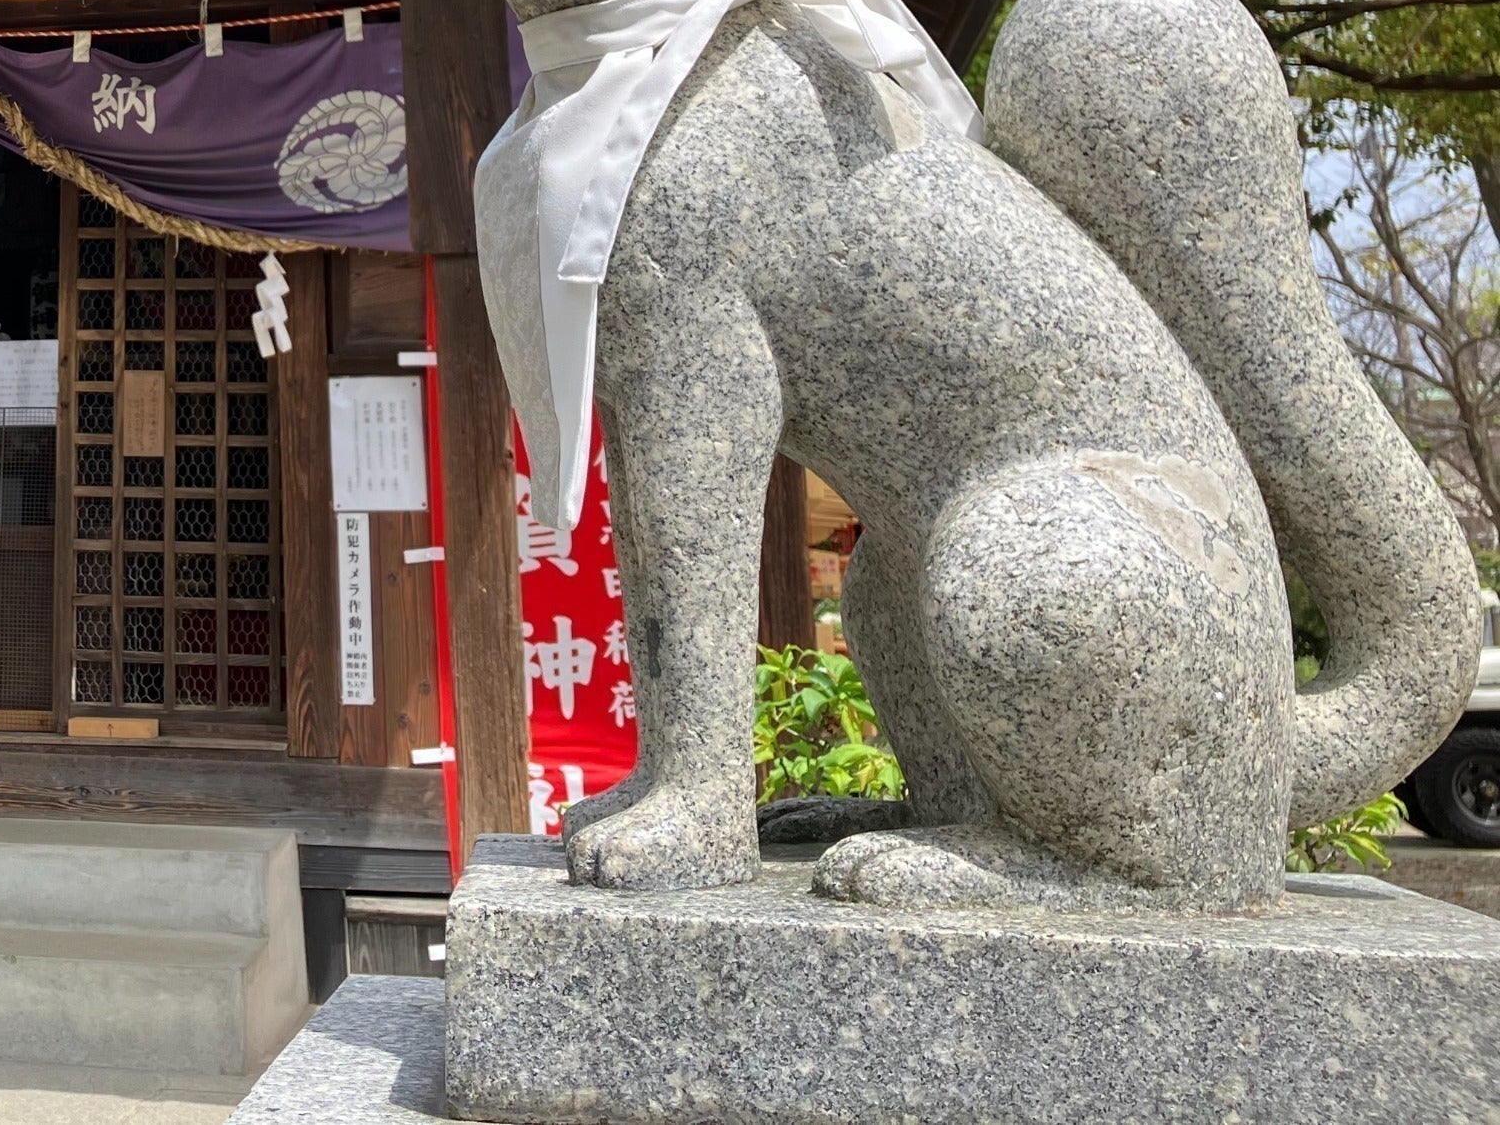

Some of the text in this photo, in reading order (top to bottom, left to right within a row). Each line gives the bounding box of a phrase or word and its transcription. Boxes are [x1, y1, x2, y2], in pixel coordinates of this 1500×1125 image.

[91, 73, 157, 135] 納
[346, 518, 362, 646] 防犯カメラ作動中
